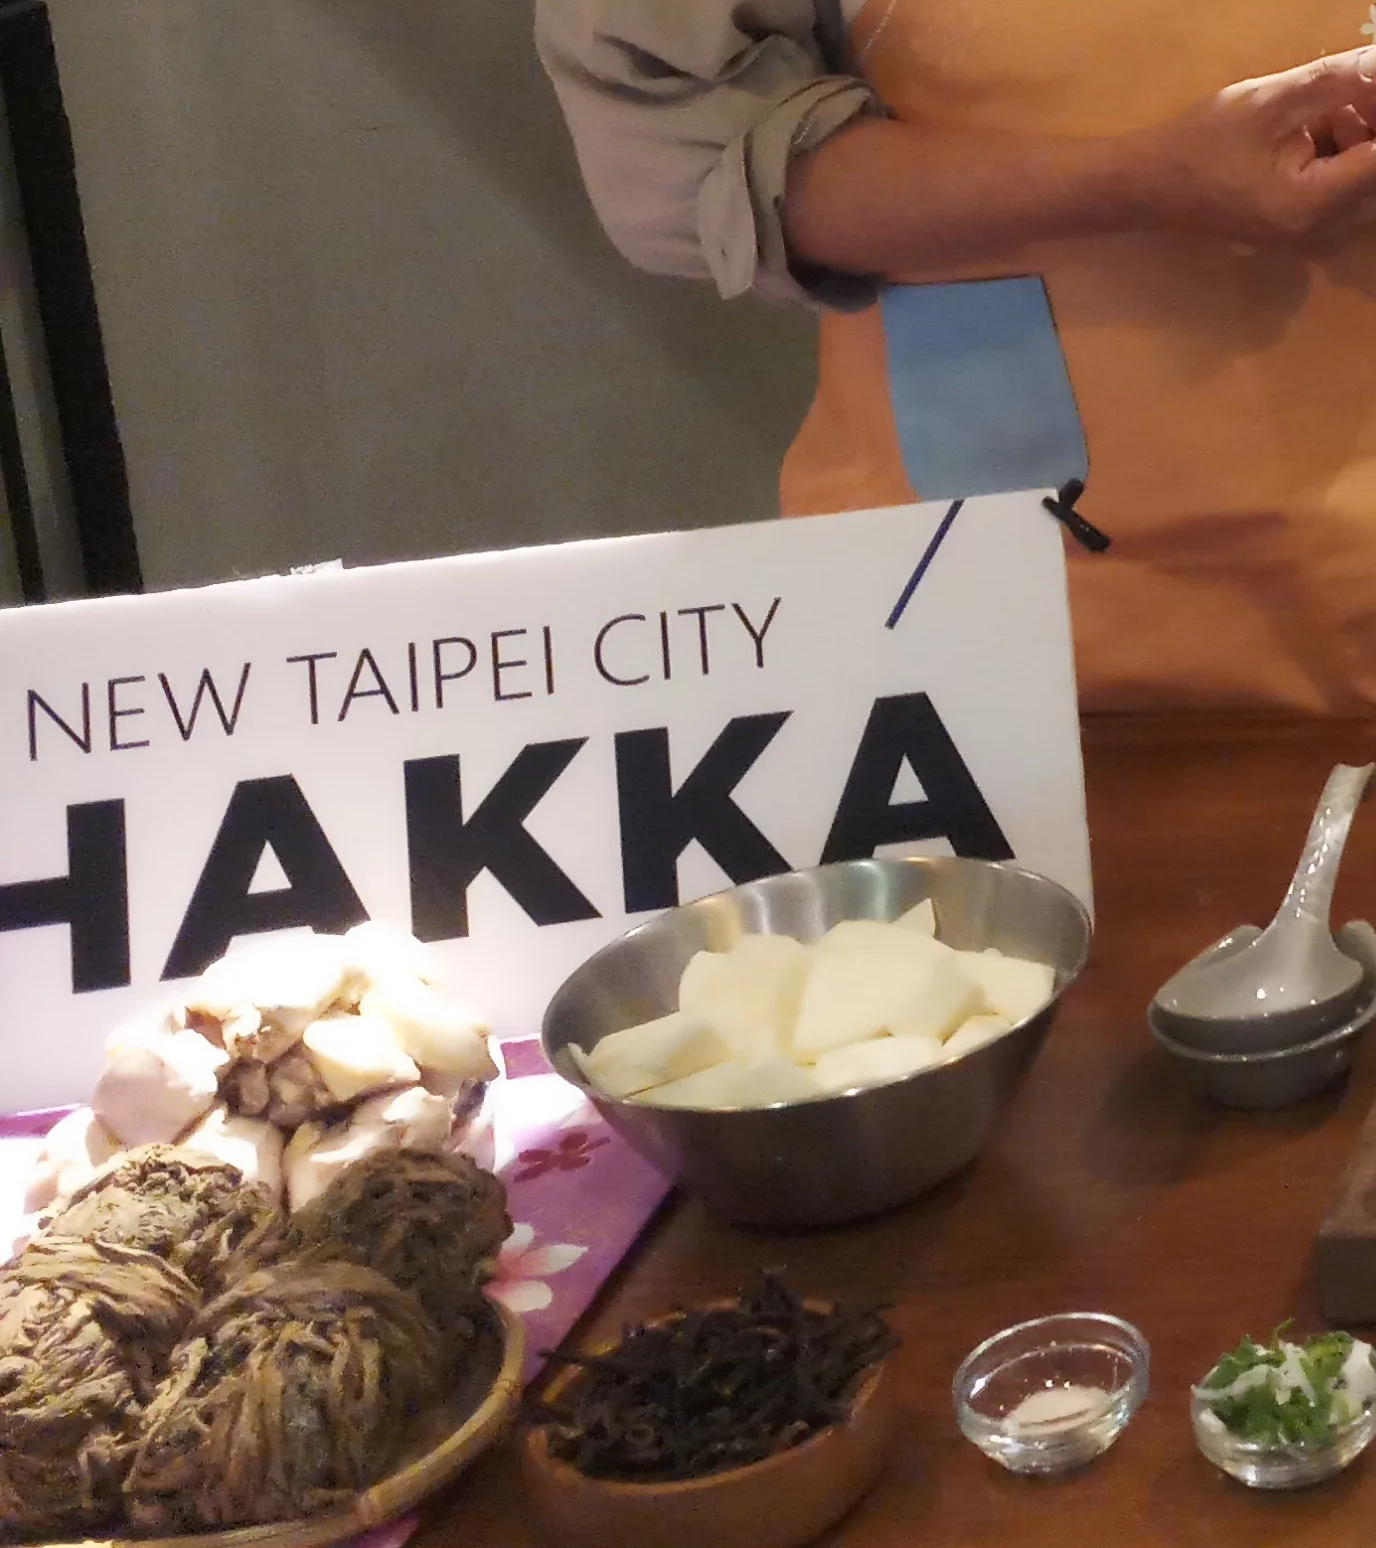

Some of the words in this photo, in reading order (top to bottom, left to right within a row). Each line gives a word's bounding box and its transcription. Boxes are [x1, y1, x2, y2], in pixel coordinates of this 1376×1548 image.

[26, 660, 251, 763] NEW
[286, 624, 560, 726] TAIPEI
[592, 595, 783, 686] CITY
[0, 690, 1016, 995] HAKKA
